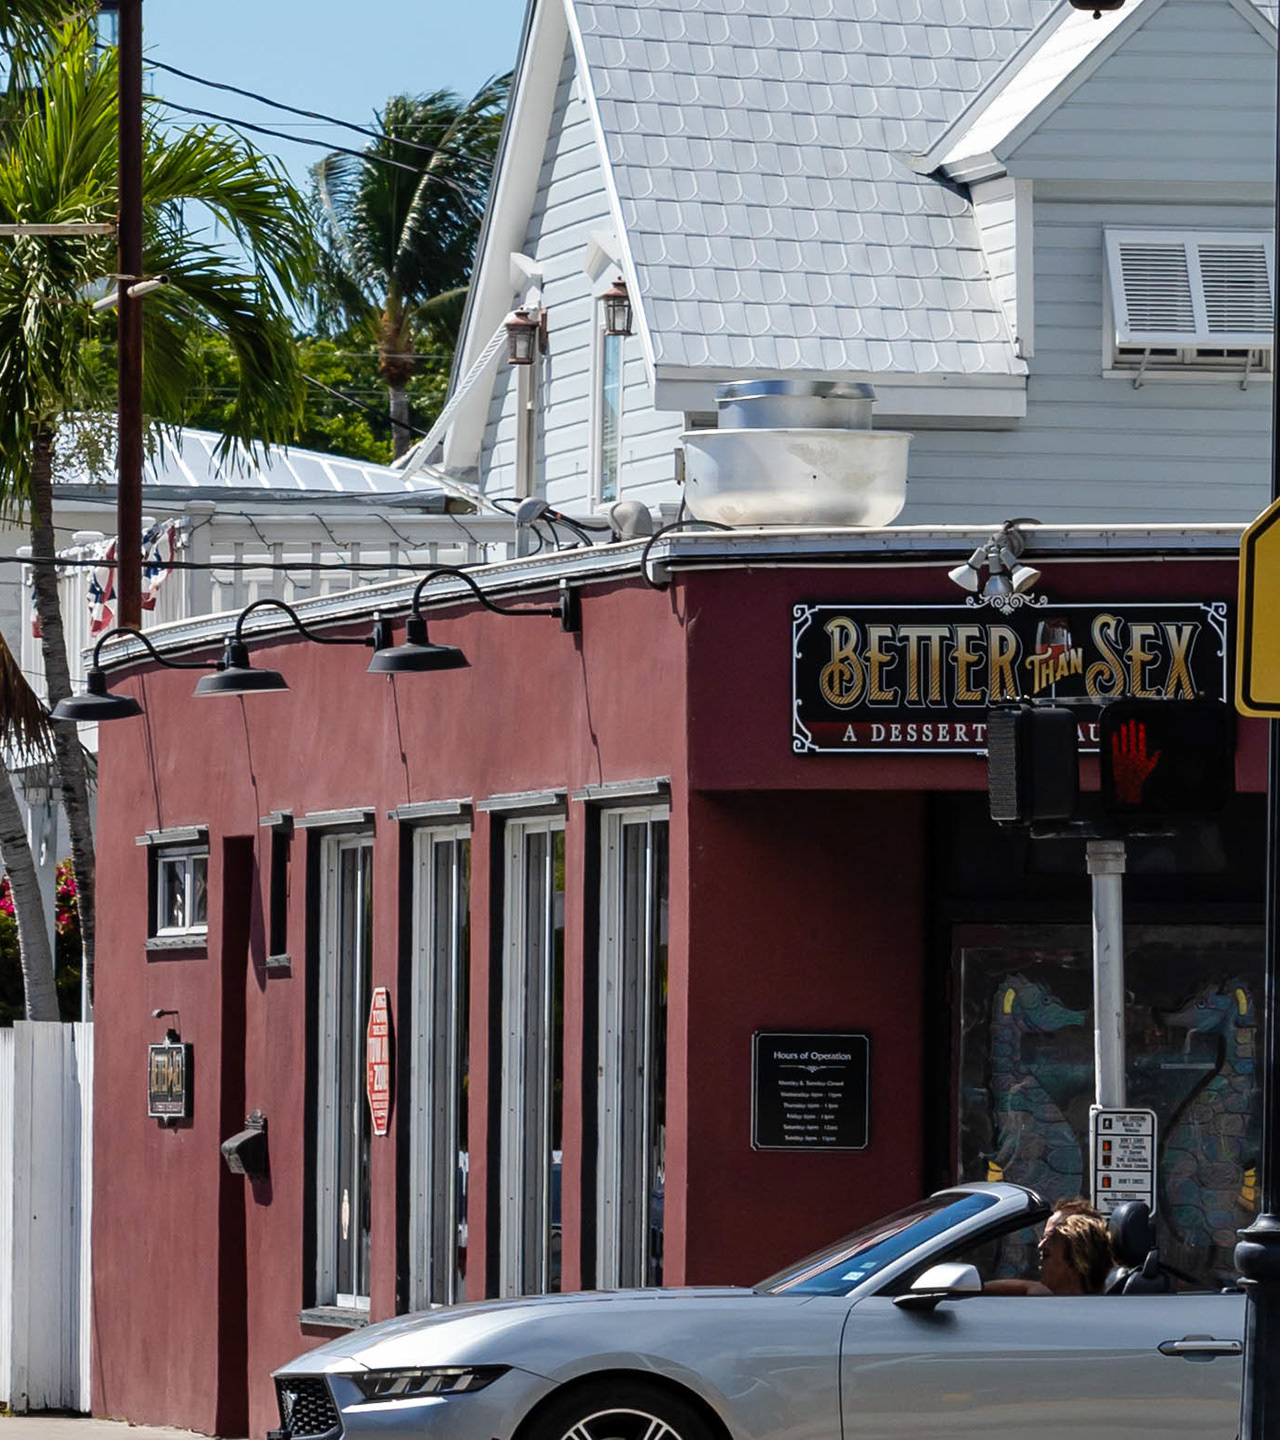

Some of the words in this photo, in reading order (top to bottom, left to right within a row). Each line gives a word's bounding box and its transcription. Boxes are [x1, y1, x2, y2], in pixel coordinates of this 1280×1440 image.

[819, 616, 1023, 710] BETTER
[1025, 647, 1084, 696] THAN
[1085, 612, 1202, 700] SEX
[842, 724, 858, 742] A
[871, 723, 987, 742] DESSERT
[773, 1051, 798, 1060] Hours
[799, 1051, 809, 1060] of
[810, 1051, 852, 1061] Operation
